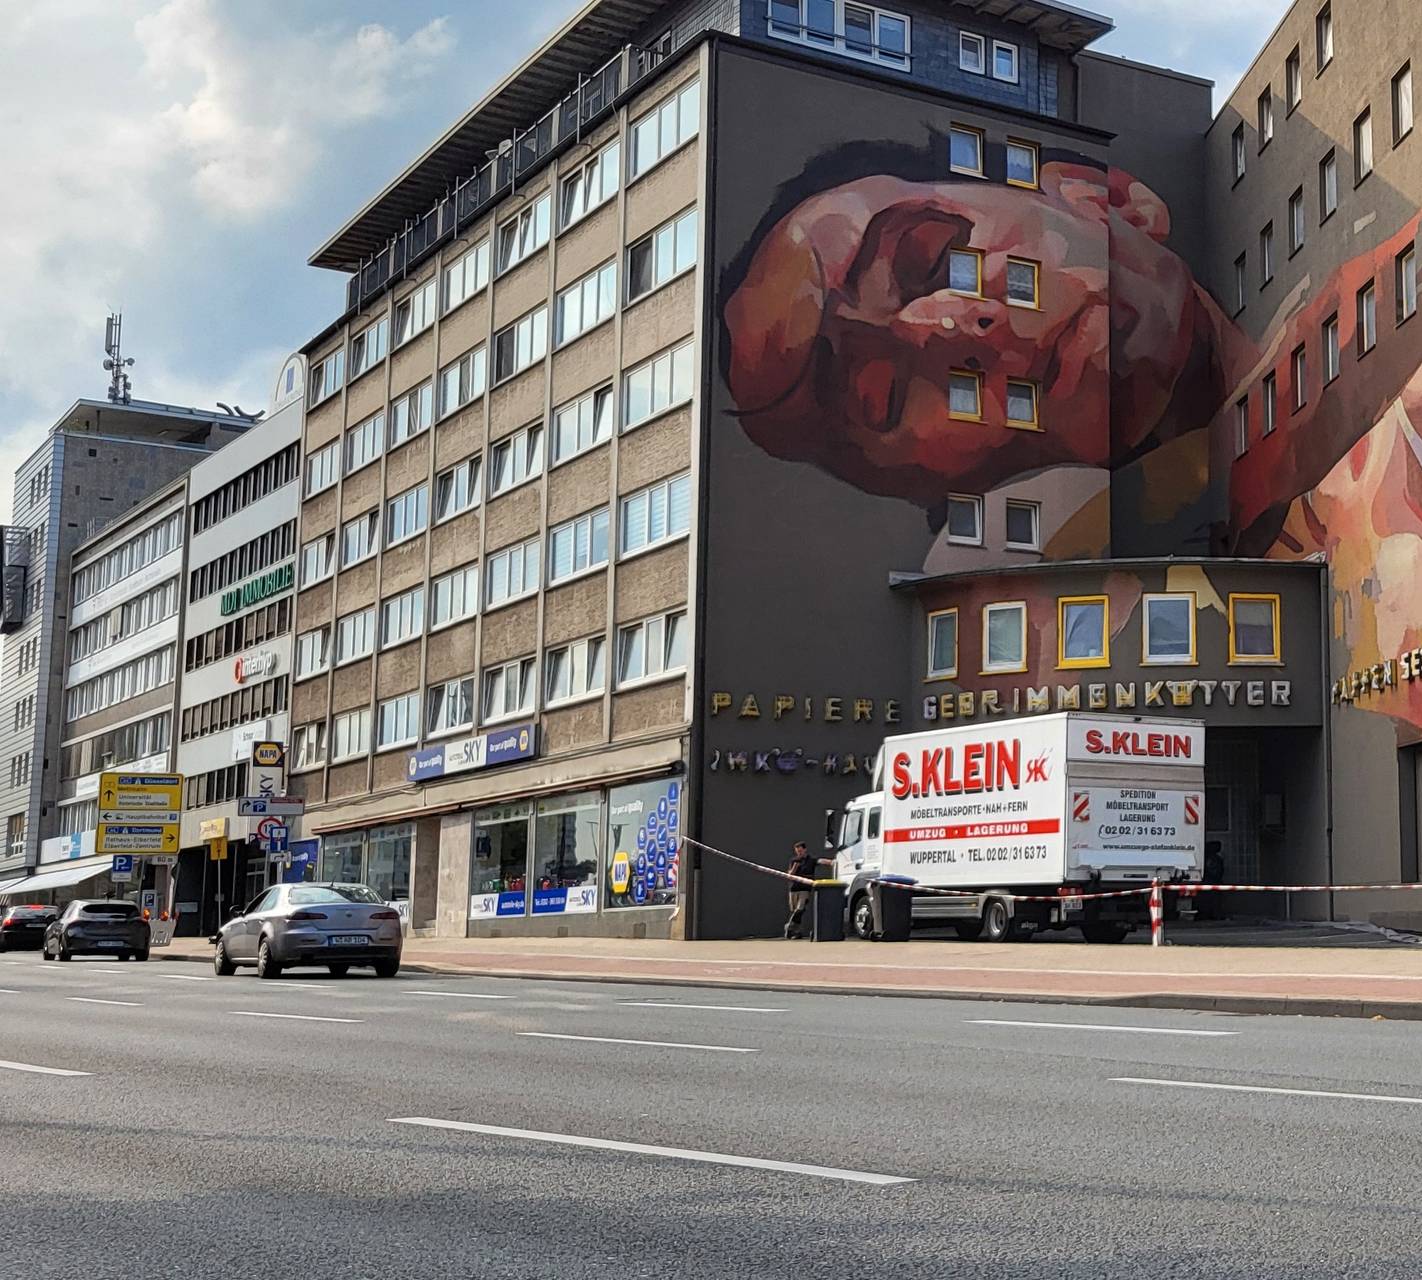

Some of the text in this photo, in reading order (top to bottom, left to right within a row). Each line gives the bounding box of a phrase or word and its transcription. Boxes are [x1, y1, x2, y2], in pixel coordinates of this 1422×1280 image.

[711, 691, 901, 722] PAPIERE
[463, 739, 482, 763] SKY
[1085, 729, 1191, 758] S.KLEIN
[259, 749, 277, 759] NAPA
[892, 738, 1021, 800] S.KLEIN
[1120, 789, 1156, 799] SPEDITION
[1106, 800, 1169, 811] MÖBELTRANSPORT
[1119, 813, 1156, 822] LAGERUNG
[909, 822, 1028, 840] UMZUG LAGERUNG
[910, 849, 957, 865] WUPPERTAL
[614, 863, 627, 882] NAPA
[483, 898, 495, 913] SKY
[581, 889, 596, 906] SKY
